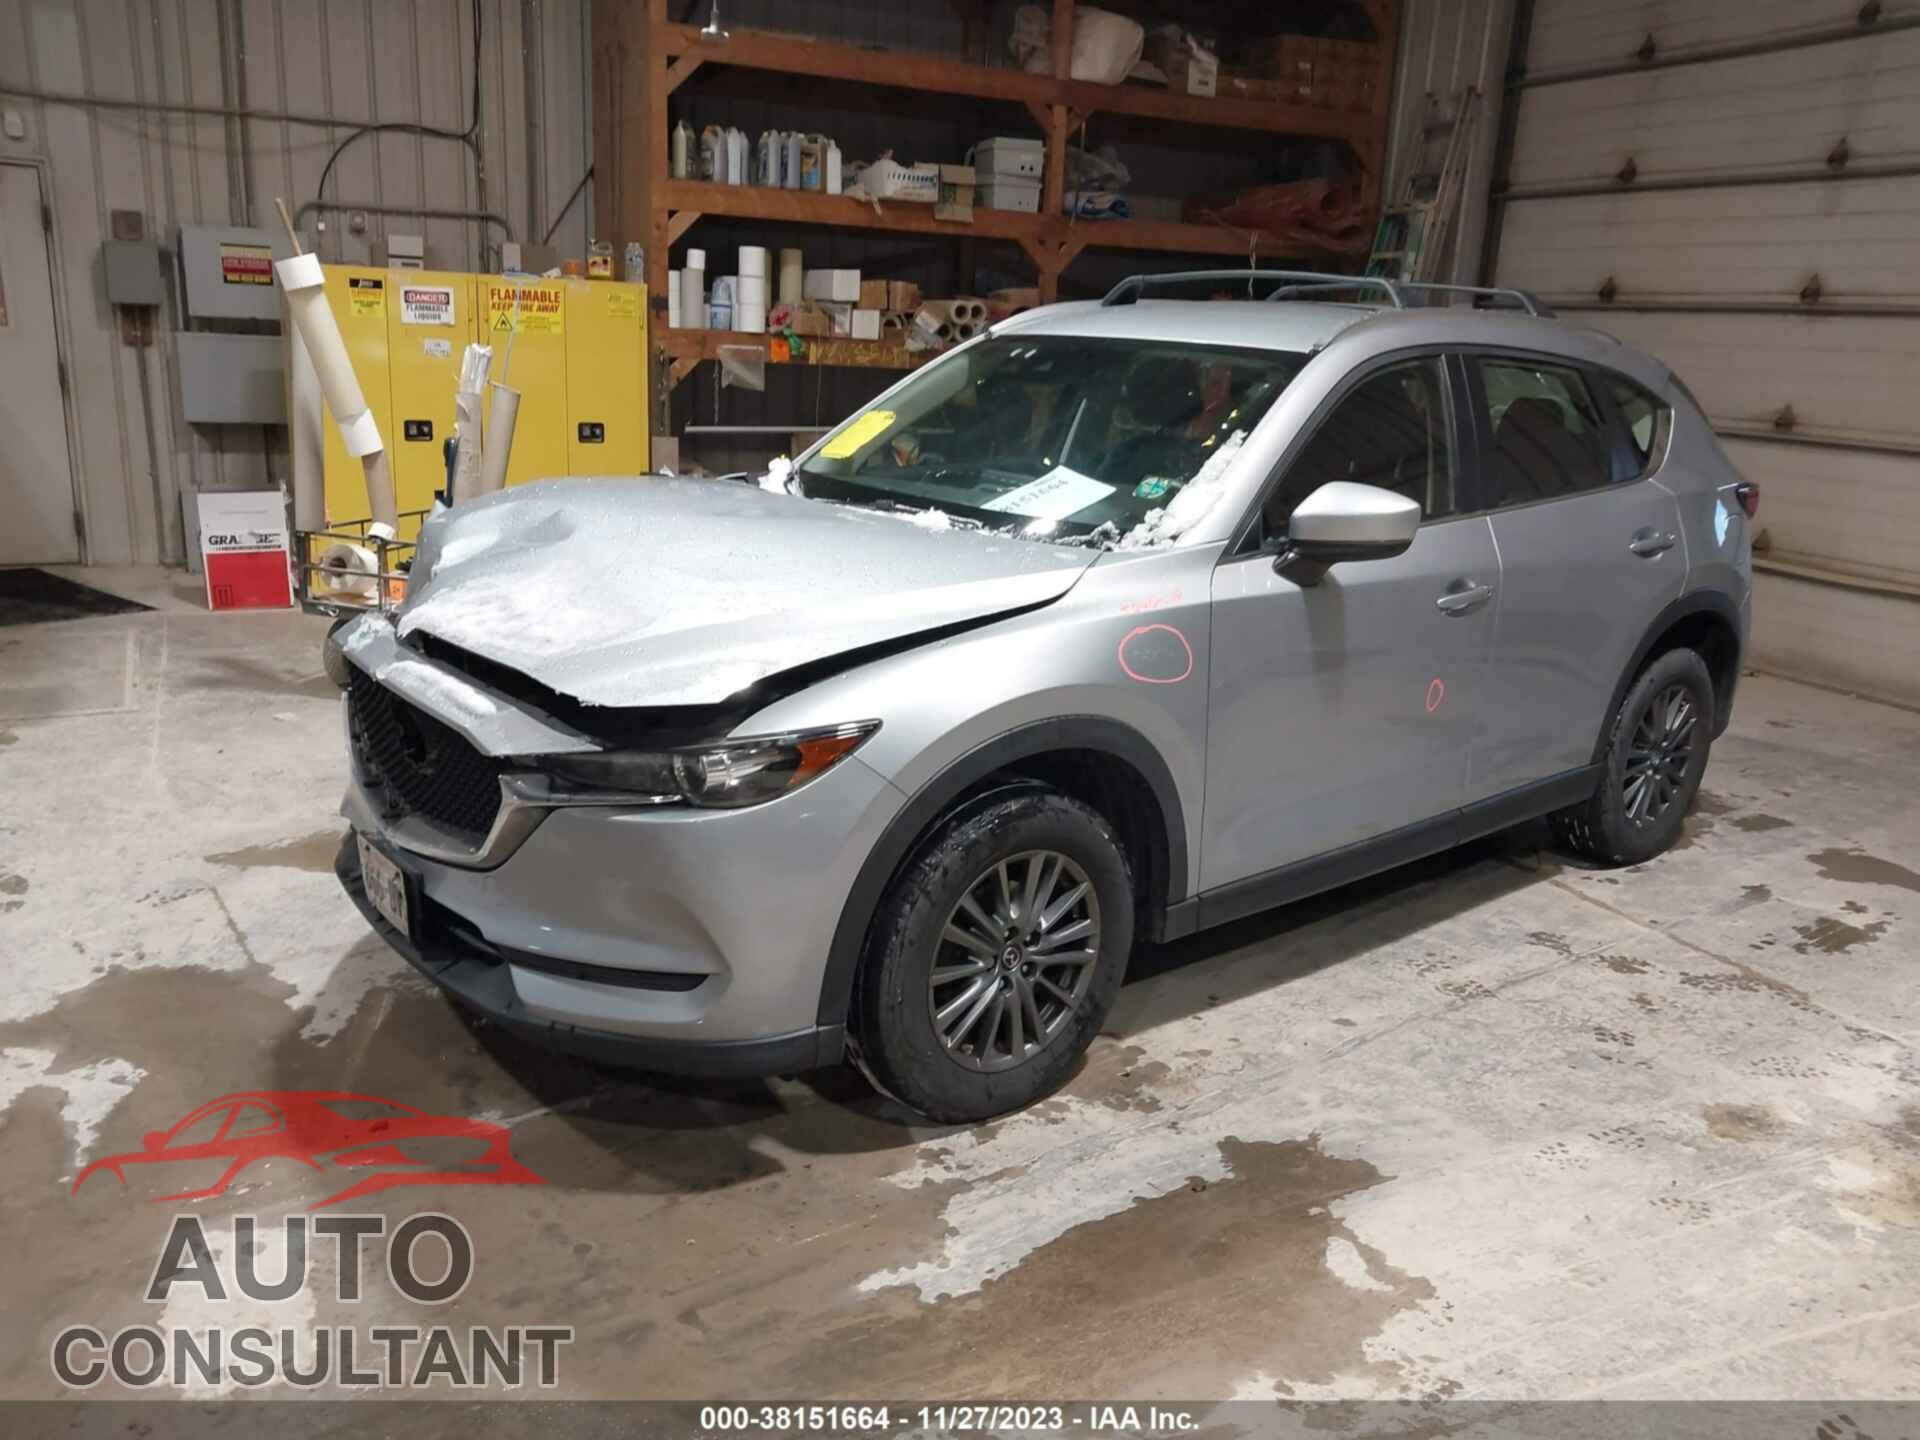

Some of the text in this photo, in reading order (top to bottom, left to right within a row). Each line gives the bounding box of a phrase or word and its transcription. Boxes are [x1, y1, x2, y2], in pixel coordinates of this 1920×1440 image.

[406, 291, 449, 304] DANGER
[490, 287, 561, 304] FLAMMABLE
[406, 303, 449, 313] FLAMMABLE
[491, 301, 560, 313] KEEP IRE AWAY
